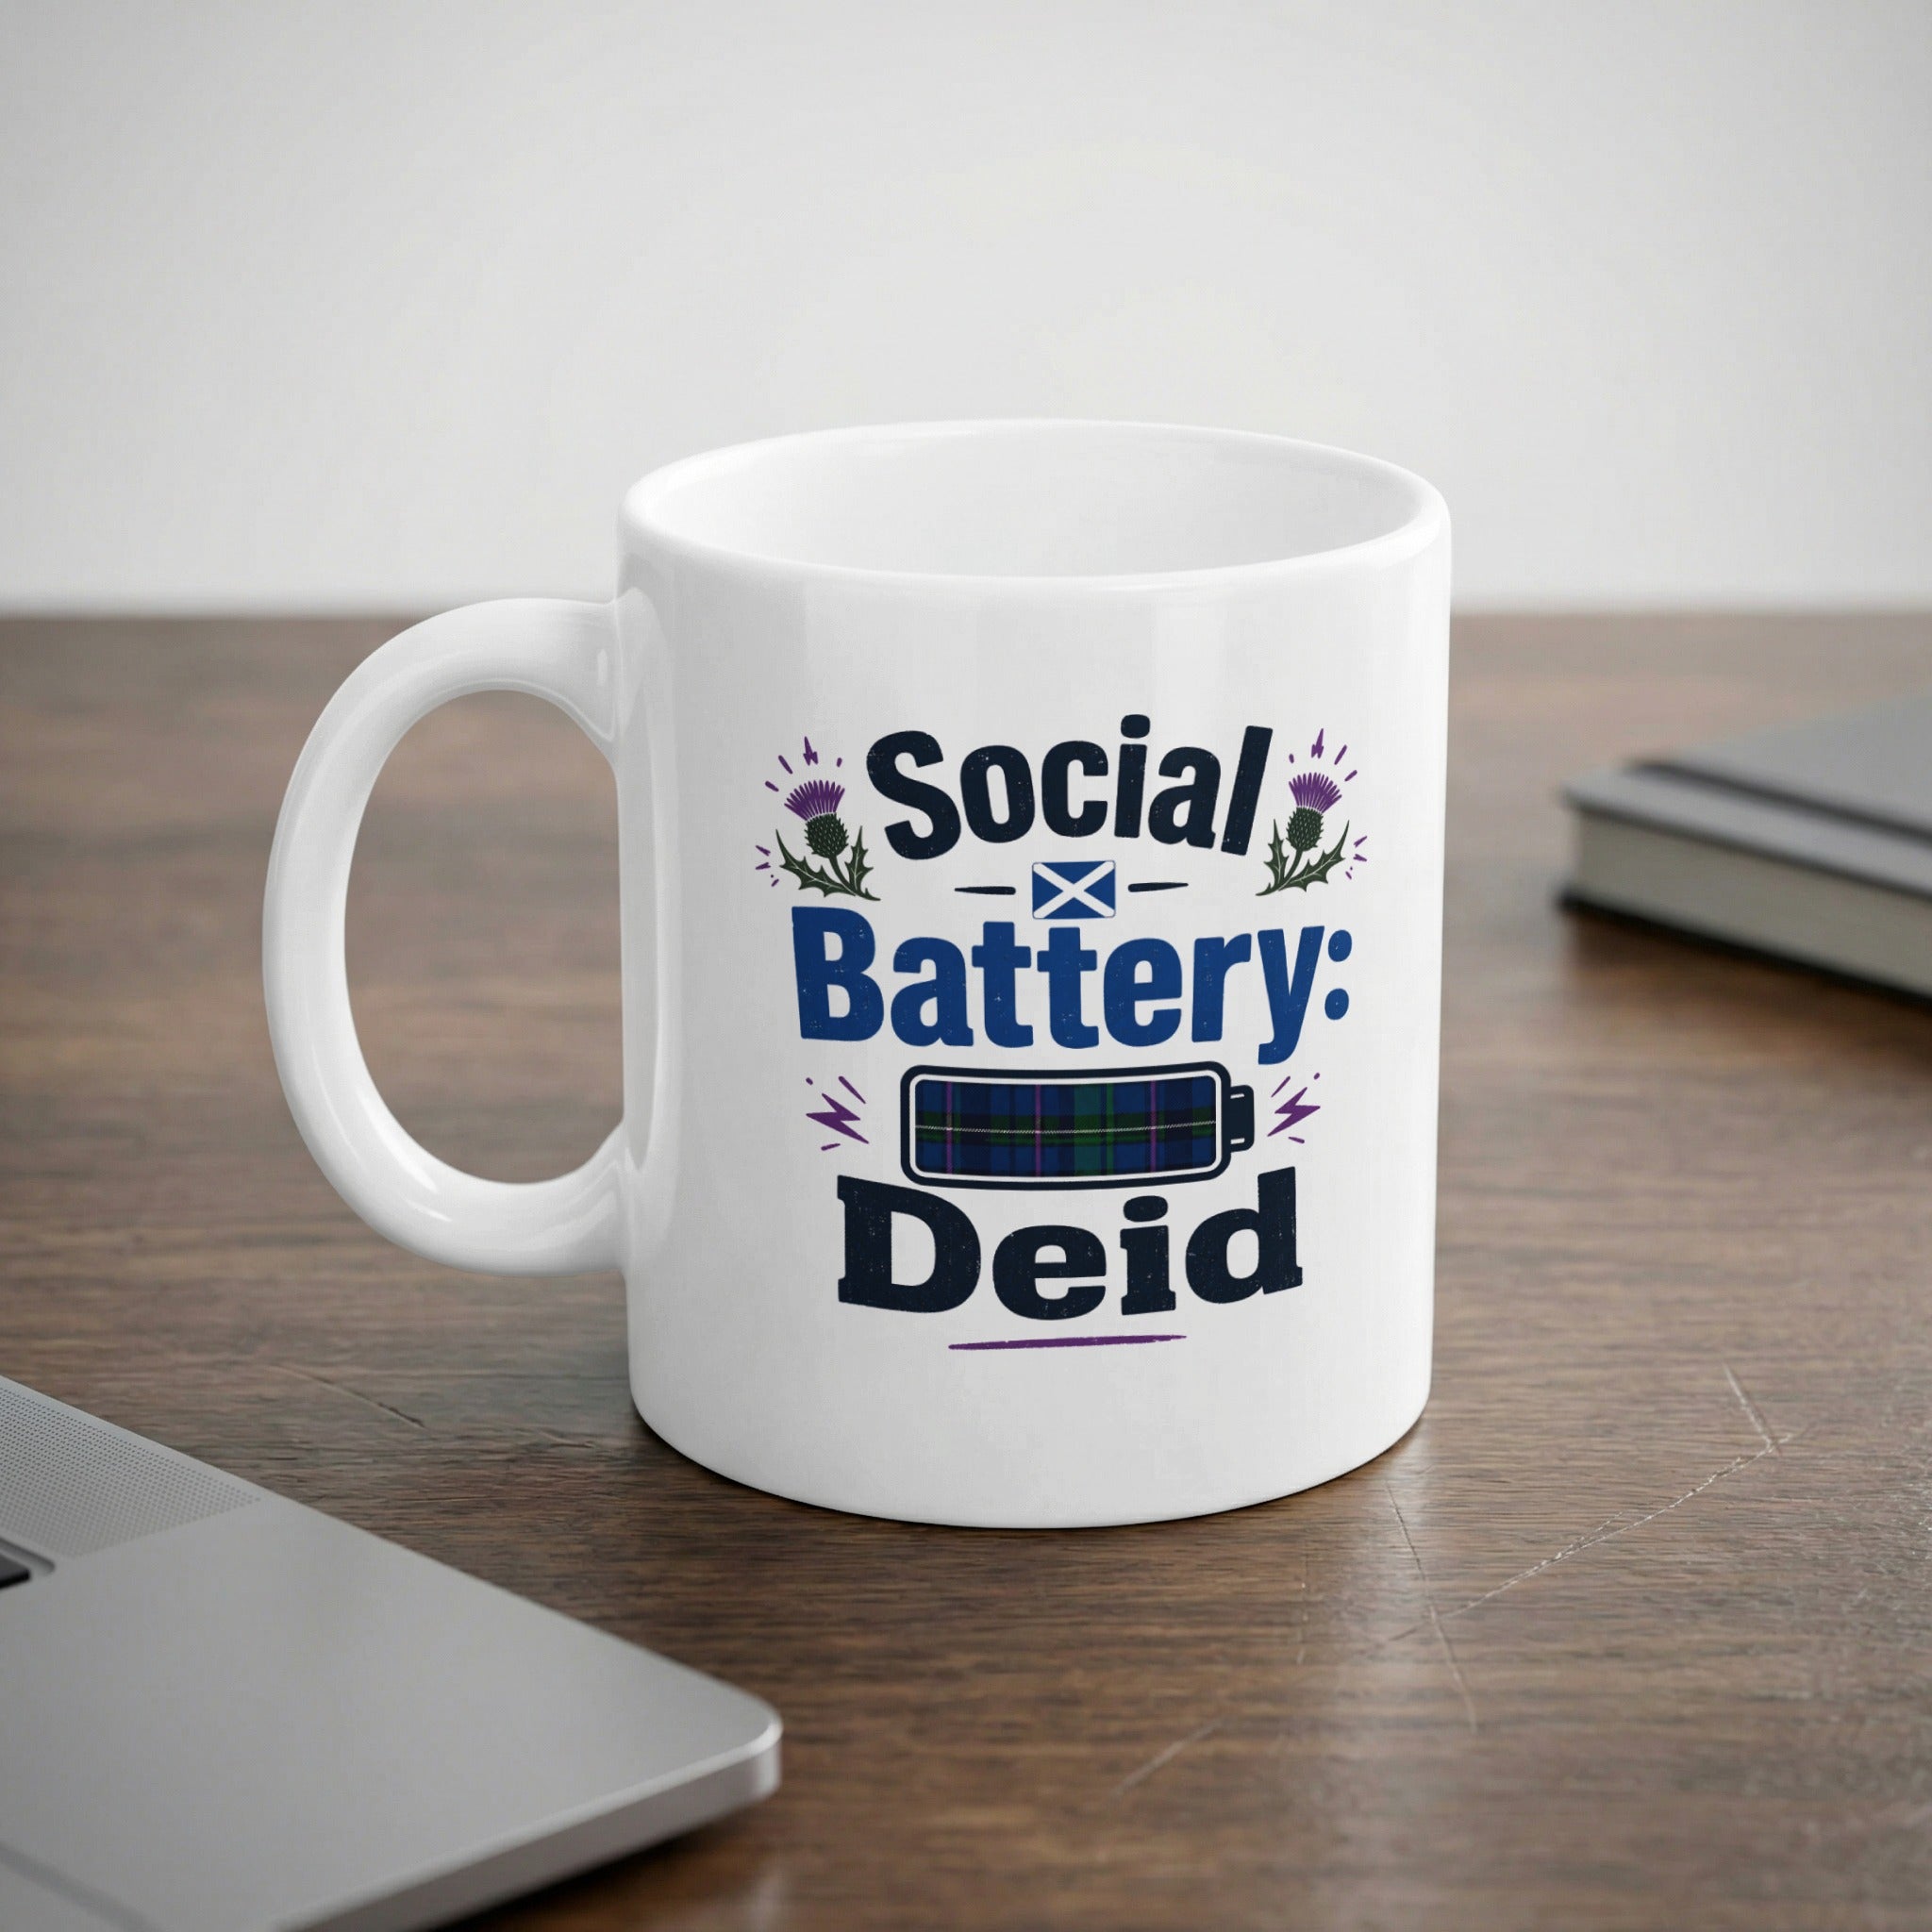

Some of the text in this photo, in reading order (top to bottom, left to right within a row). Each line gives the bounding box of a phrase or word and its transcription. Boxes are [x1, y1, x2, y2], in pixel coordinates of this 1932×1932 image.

[865, 713, 1274, 861] Social
[791, 906, 1353, 1066] Battery:
[836, 1166, 1304, 1322] Deid
